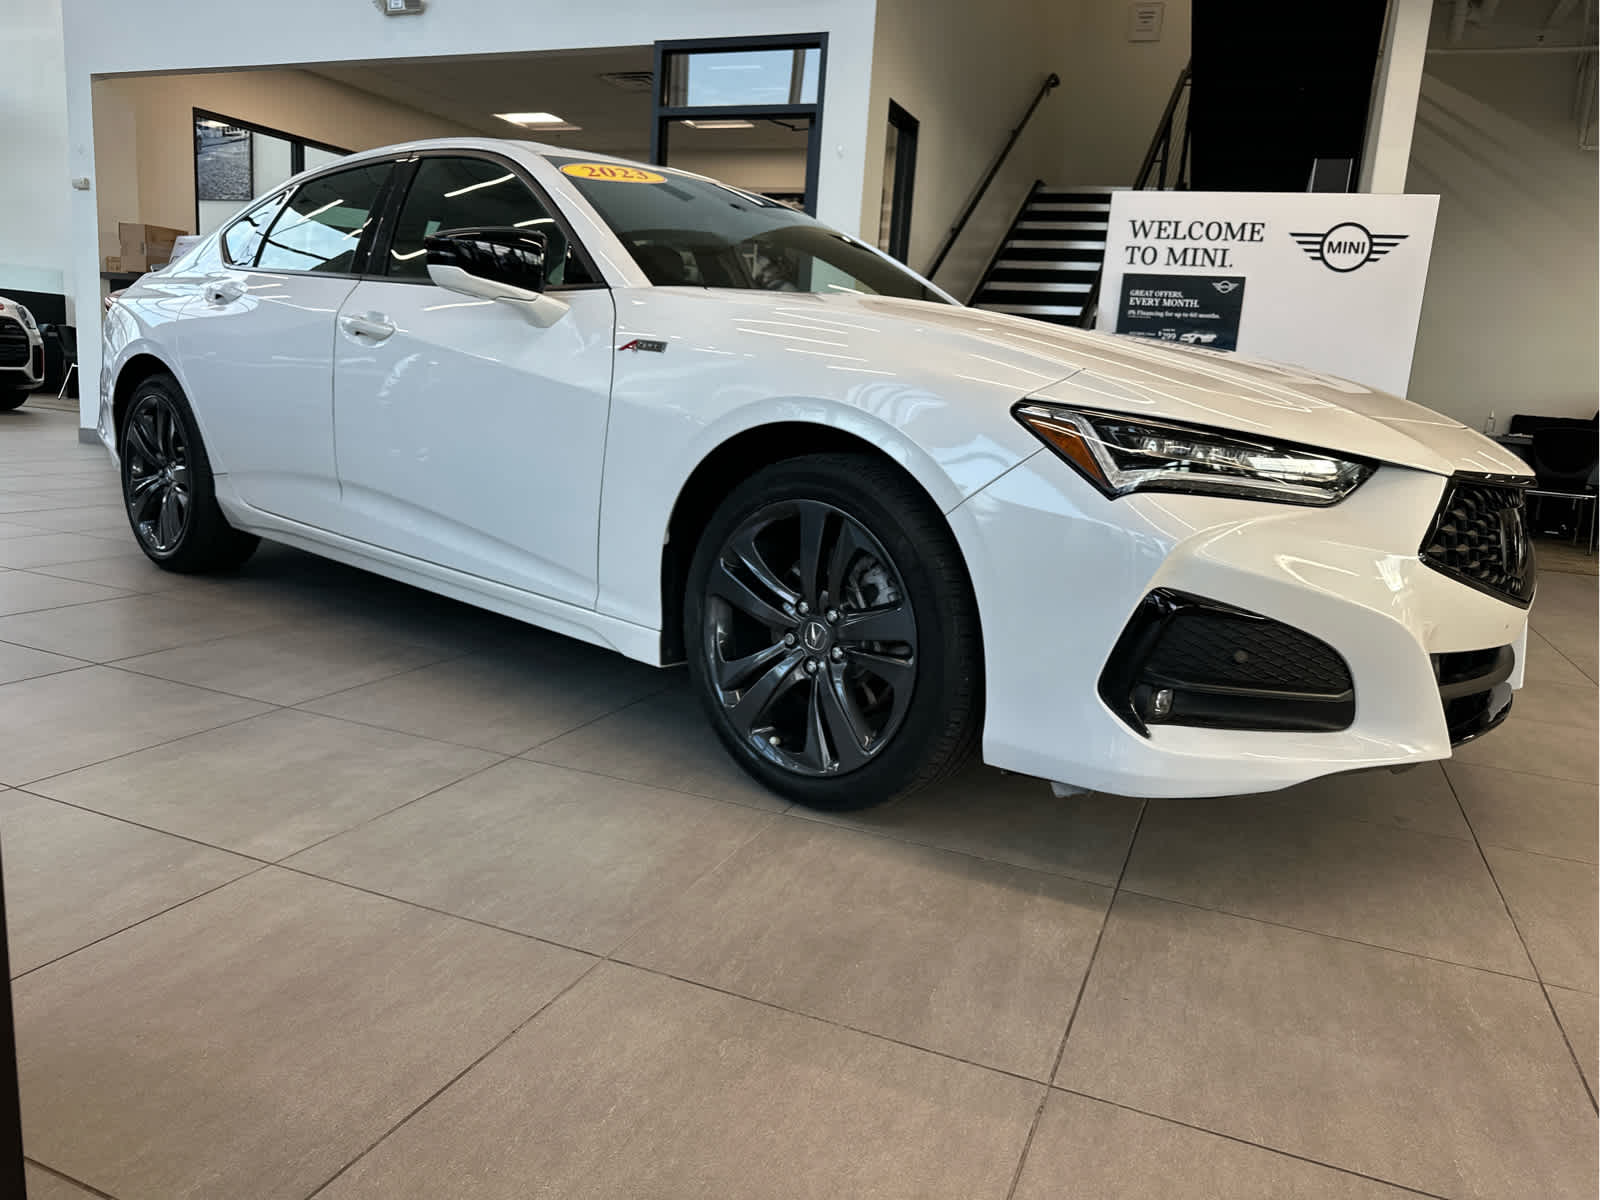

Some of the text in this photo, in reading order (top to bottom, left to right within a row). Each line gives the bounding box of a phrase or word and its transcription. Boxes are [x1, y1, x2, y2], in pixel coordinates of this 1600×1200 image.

[582, 165, 649, 180] 2023
[1129, 219, 1266, 242] WELCOME
[1327, 241, 1366, 254] MINI
[1125, 246, 1233, 268] TO MINI.
[1129, 289, 1154, 297] GREAT
[1129, 297, 1200, 308] EVERY MONTH.
